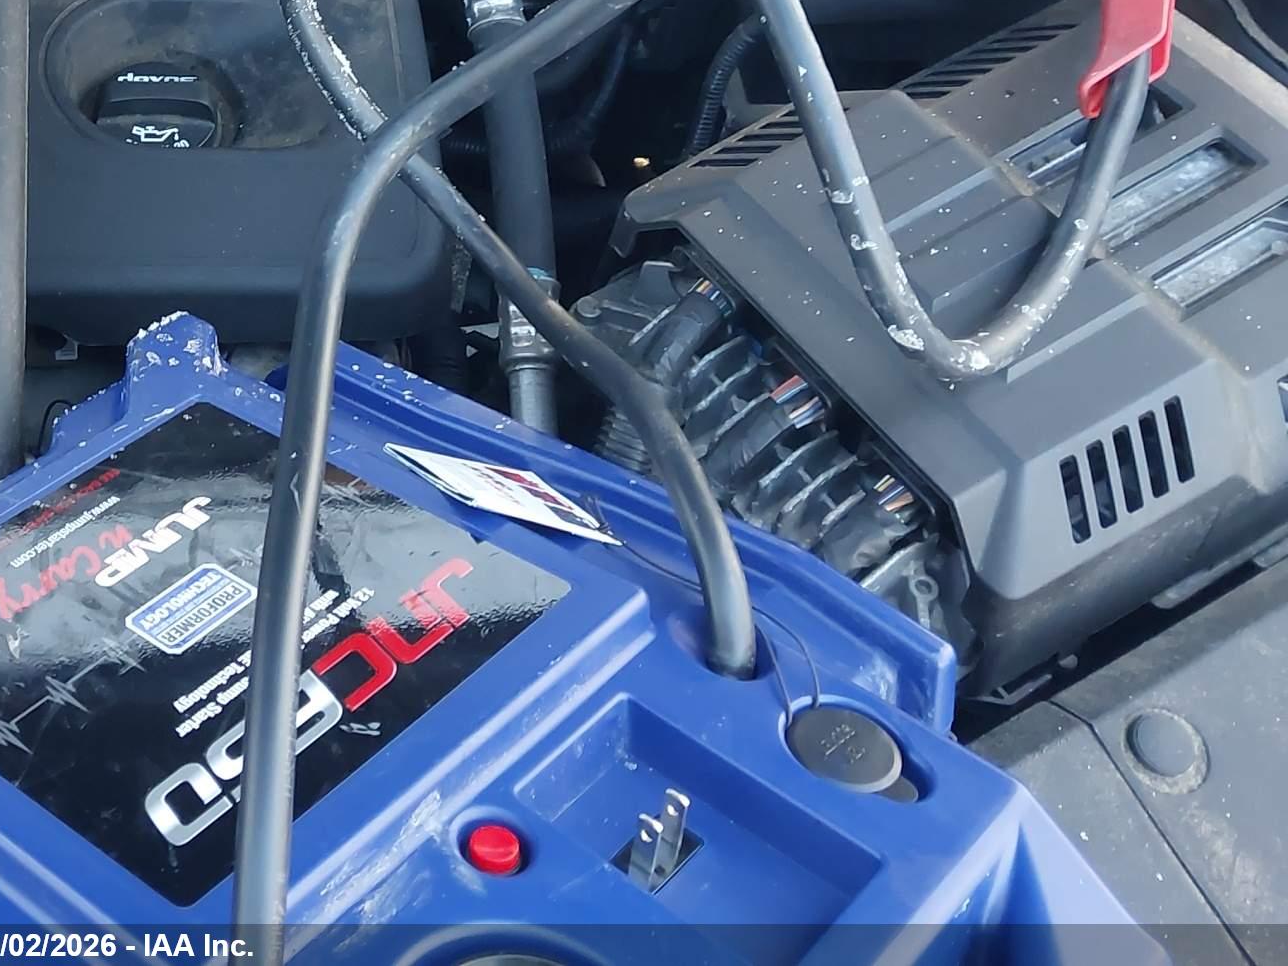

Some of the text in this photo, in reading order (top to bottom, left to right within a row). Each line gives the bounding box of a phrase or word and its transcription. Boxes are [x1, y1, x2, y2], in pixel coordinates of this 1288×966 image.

[8, 494, 121, 571] www.jumpstarter.com
[92, 495, 211, 589] JUMP
[138, 570, 221, 631] TECHNOLOGY
[159, 583, 243, 643] PROFORMER
[332, 597, 360, 619] Volt
[352, 585, 376, 604] 12
[173, 588, 340, 714] with Technology
[299, 612, 339, 642] Power
[174, 699, 222, 738] Starter
